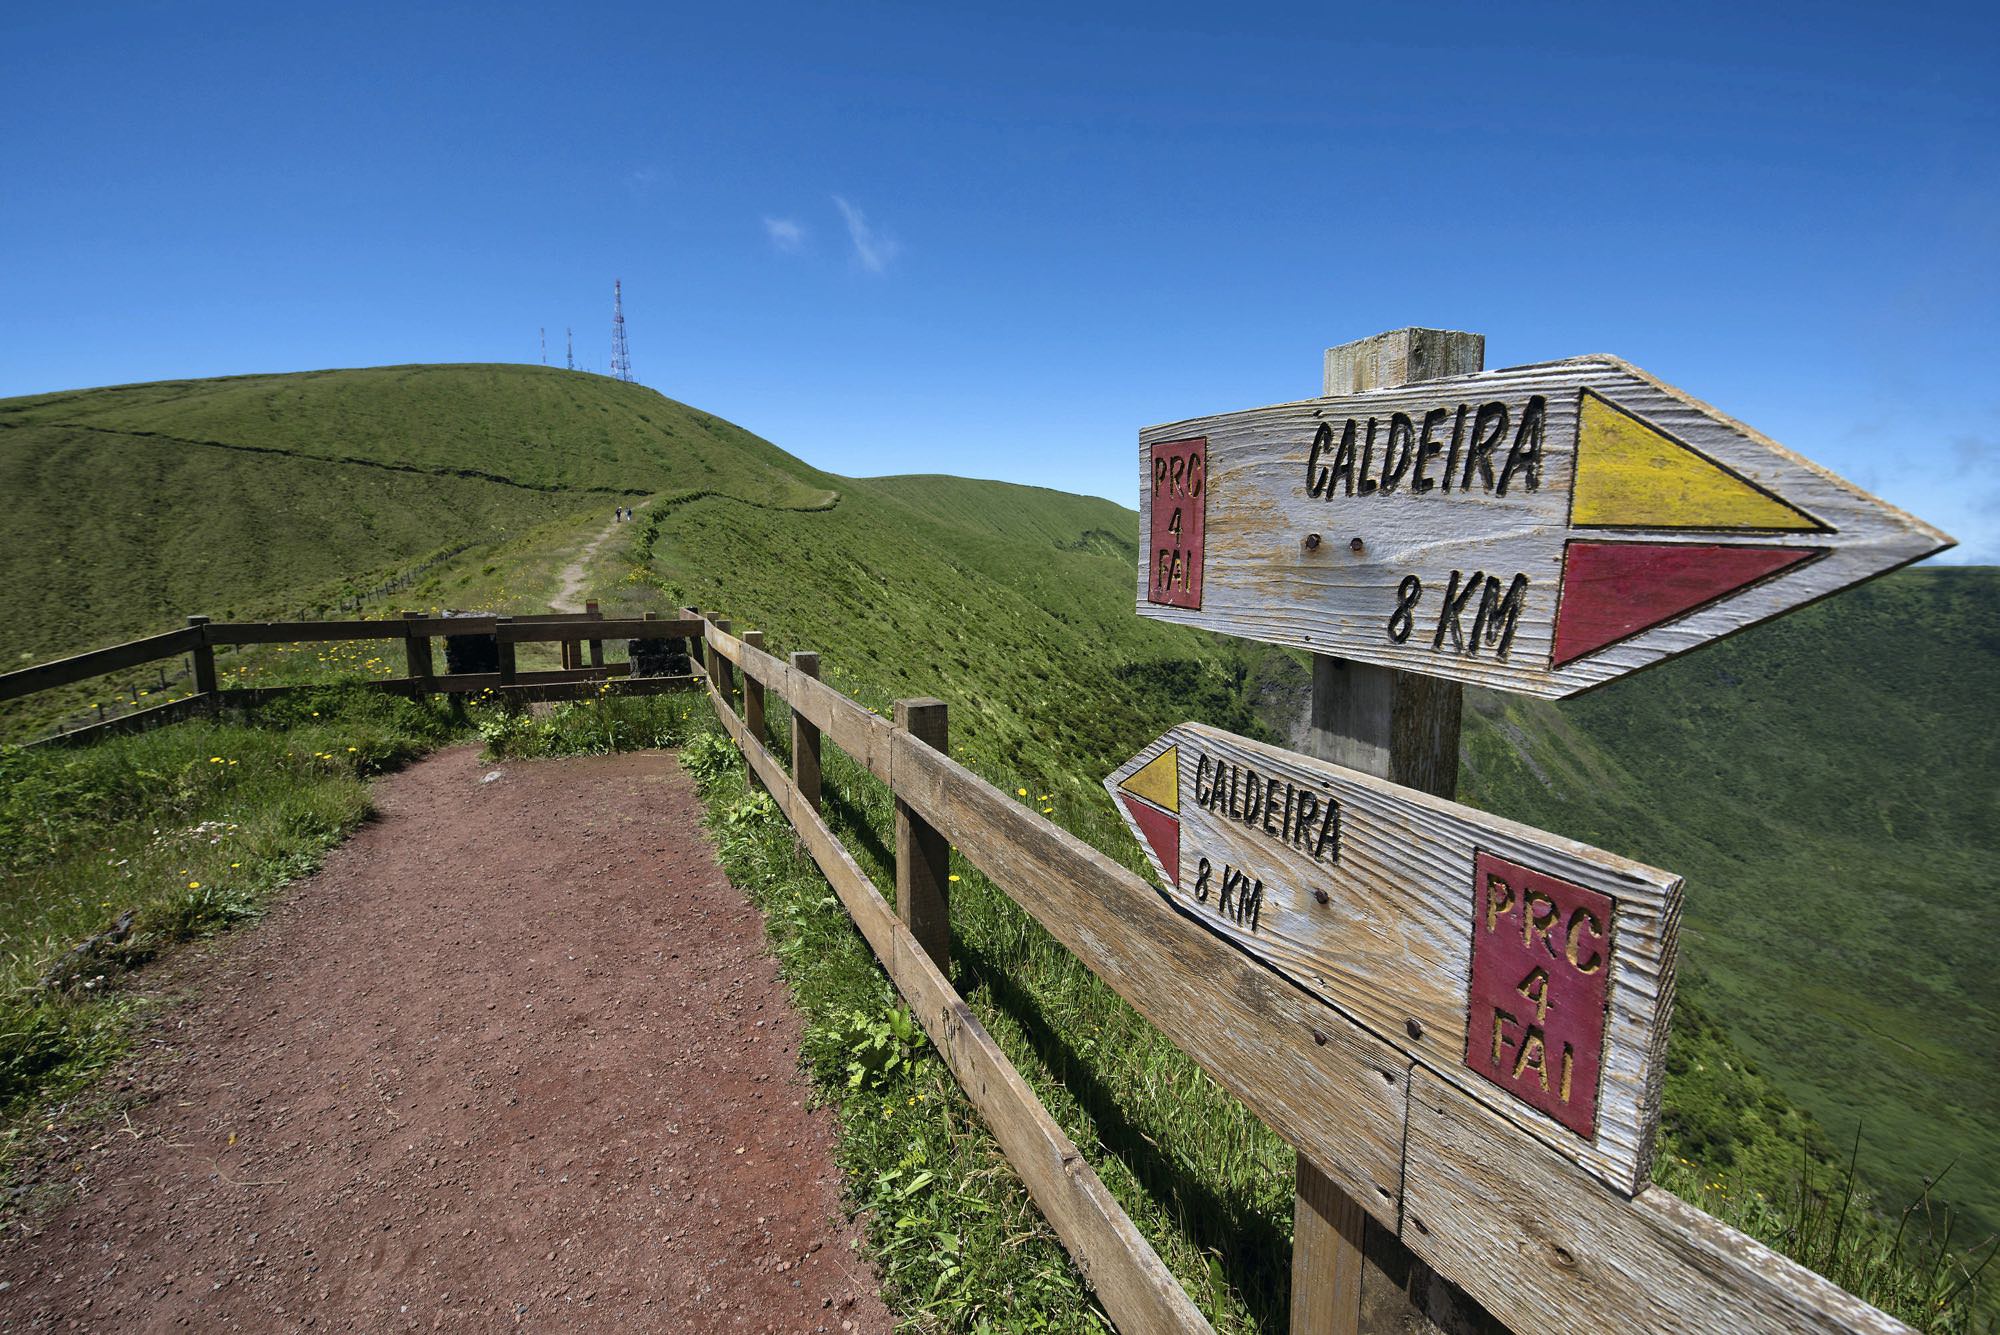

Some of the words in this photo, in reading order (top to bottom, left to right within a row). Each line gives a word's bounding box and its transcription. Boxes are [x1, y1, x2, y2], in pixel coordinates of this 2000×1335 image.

[1154, 452, 1202, 500] PRC
[1305, 394, 1548, 502] CALDEIRA
[1167, 507, 1183, 548] 4
[1158, 548, 1192, 594] FAI
[1387, 573, 1423, 645] 8
[1431, 569, 1530, 663] KM
[1195, 753, 1341, 865] CALDEIRA
[1194, 857, 1211, 905] 8
[1218, 863, 1264, 934] KM
[1485, 873, 1603, 976] PRC
[1517, 965, 1554, 1025] 4
[1492, 1007, 1574, 1104] FAI
